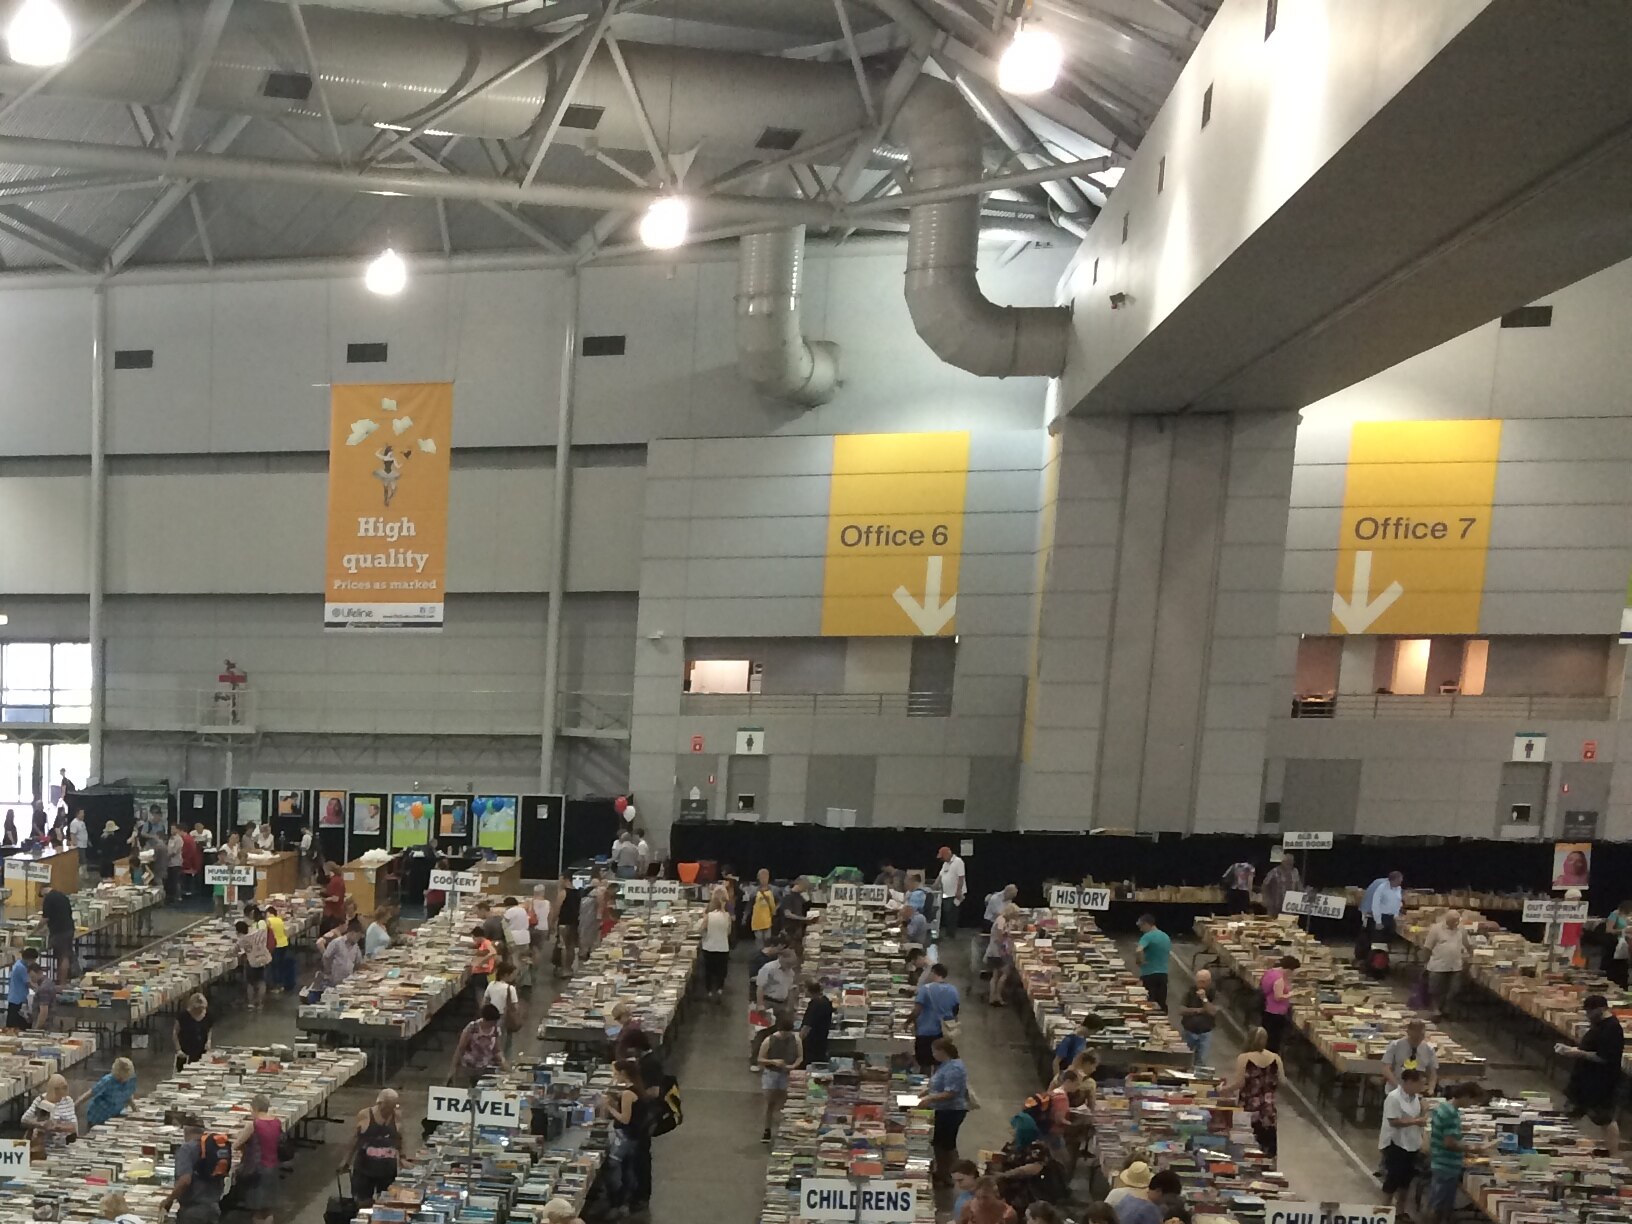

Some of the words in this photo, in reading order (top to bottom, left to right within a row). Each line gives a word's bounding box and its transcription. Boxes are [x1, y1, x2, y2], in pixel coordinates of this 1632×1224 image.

[357, 516, 416, 542] High
[840, 525, 925, 547] Office
[931, 525, 948, 546] 6
[1355, 517, 1448, 540] Office
[1459, 518, 1476, 539] 7
[343, 548, 429, 573] quality
[333, 579, 371, 590] Prices
[373, 581, 387, 590] as
[390, 579, 437, 590] marked
[432, 875, 478, 887] COOKERY
[628, 886, 676, 895] RELIGION
[1056, 889, 1108, 907] HISORY
[1286, 901, 1341, 917] COLLETABLES
[433, 1096, 516, 1117] TRAVEL
[806, 1189, 911, 1212] CHILDRENS
